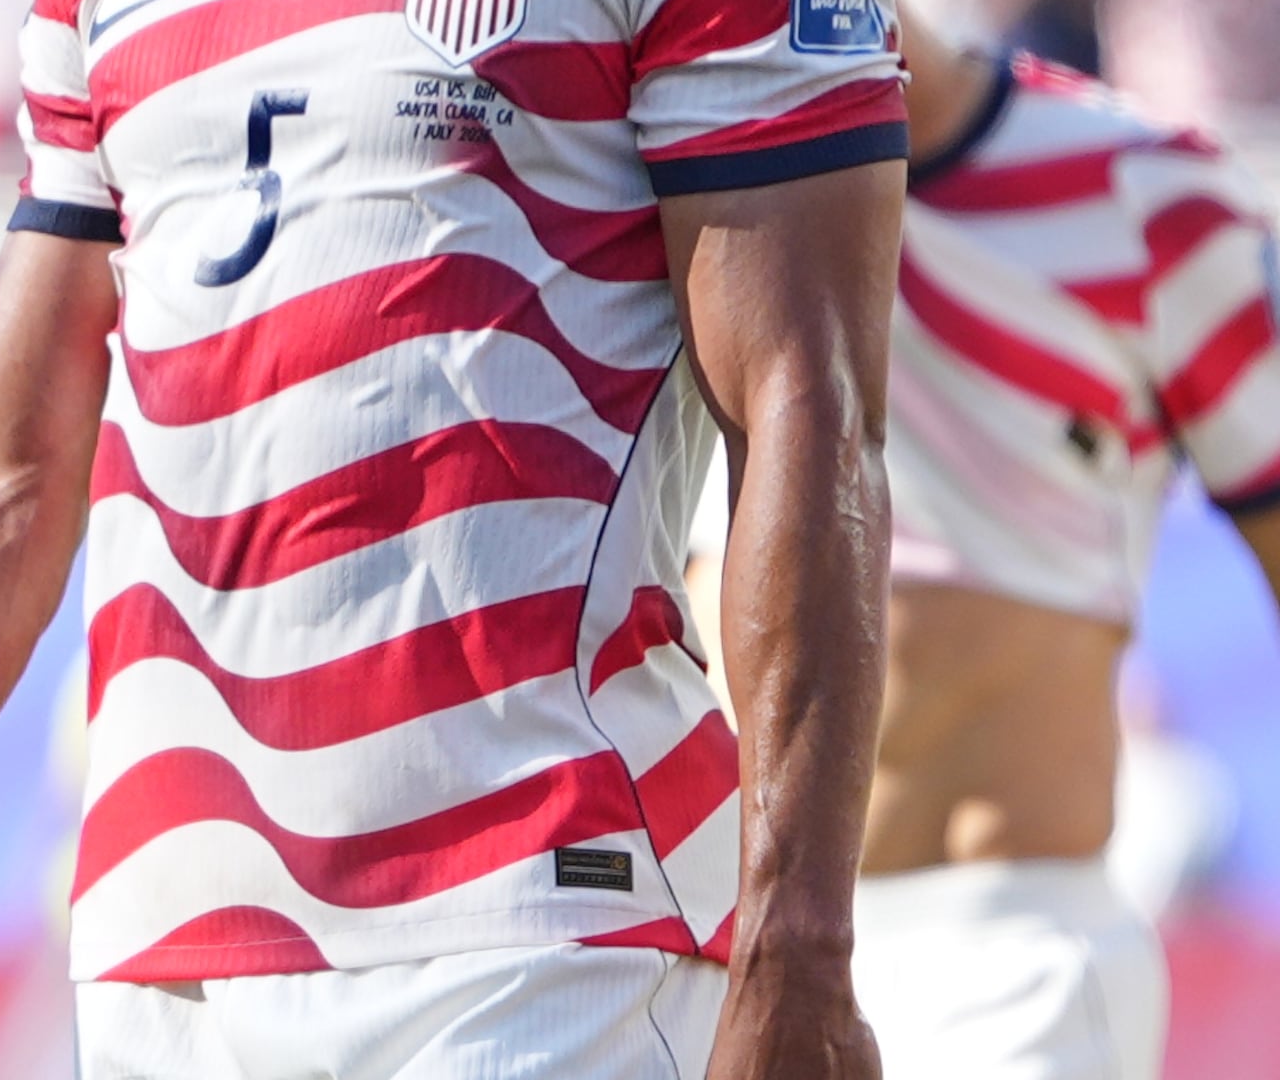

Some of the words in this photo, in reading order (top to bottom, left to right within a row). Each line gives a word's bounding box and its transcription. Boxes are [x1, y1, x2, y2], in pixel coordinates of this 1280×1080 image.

[415, 80, 440, 97] USA
[396, 101, 439, 119] SANTA
[497, 109, 514, 125] CA
[424, 124, 455, 140] JULY
[194, 87, 312, 288] 5
